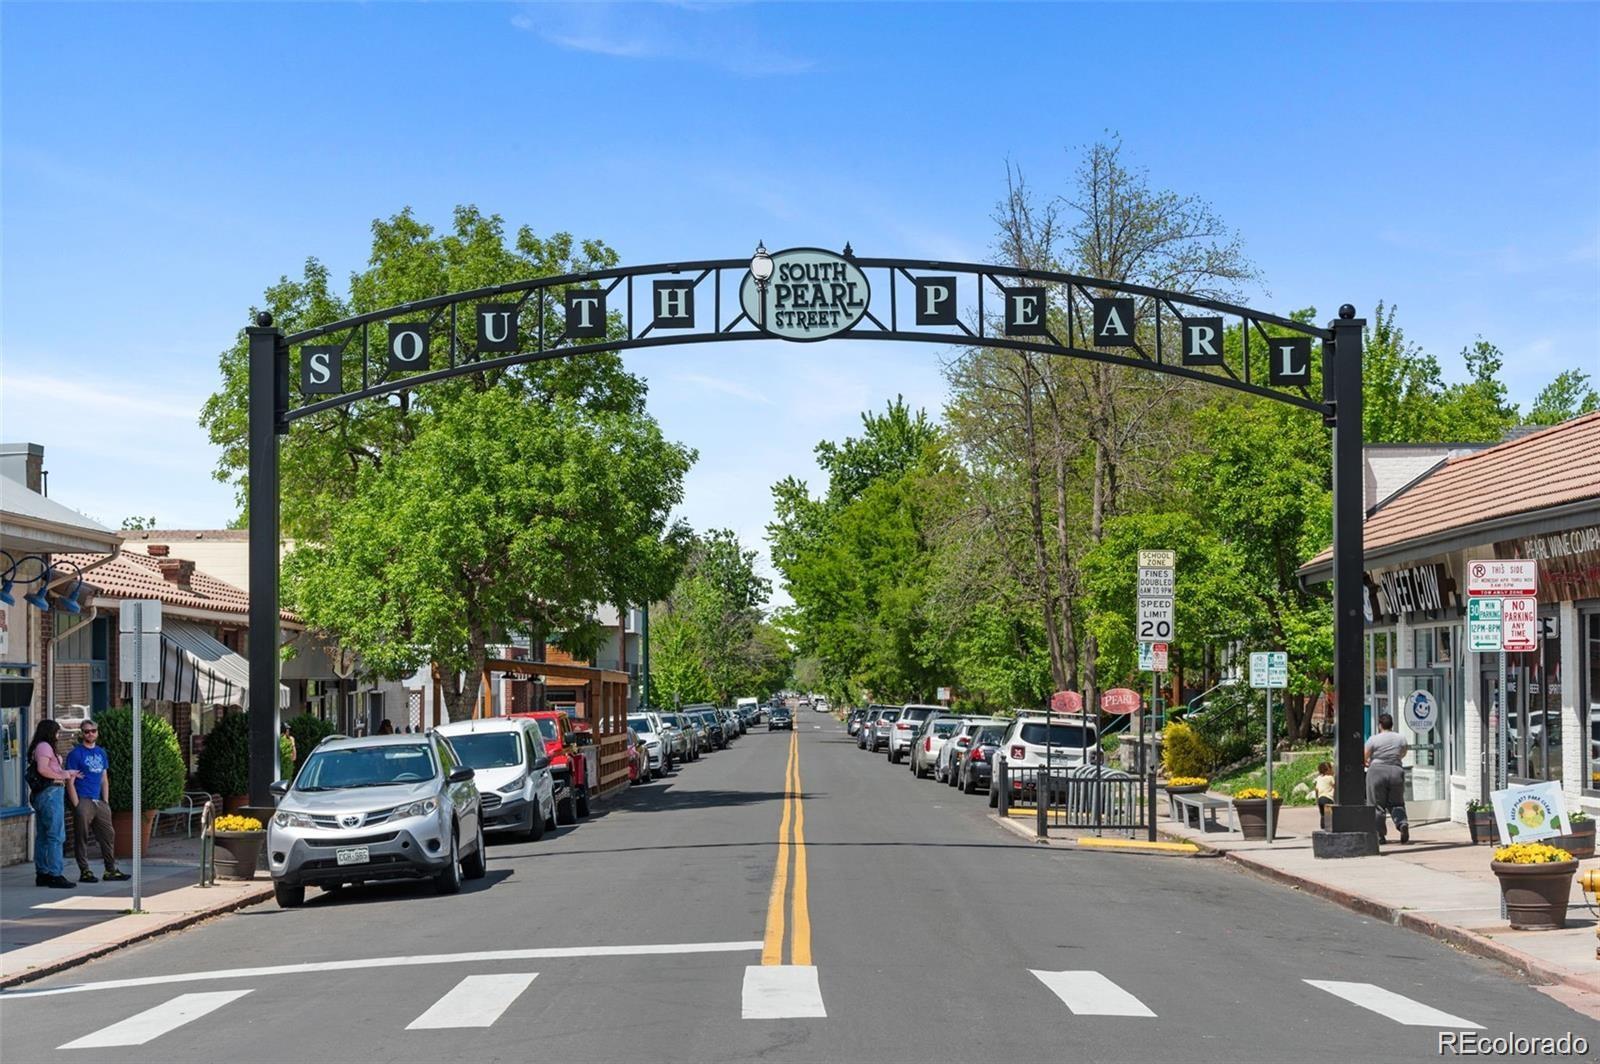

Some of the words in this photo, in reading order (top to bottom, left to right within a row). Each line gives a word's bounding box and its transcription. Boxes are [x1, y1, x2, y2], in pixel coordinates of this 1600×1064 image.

[779, 262, 847, 282] SOUTH
[775, 282, 864, 318] PEARL
[775, 311, 840, 330] STREET
[1524, 538, 1550, 560] PEARL
[1547, 534, 1572, 558] WINE
[1142, 552, 1171, 560] SCHOOL
[1145, 570, 1169, 578] FINES
[1491, 566, 1505, 574] THIS
[1510, 566, 1524, 574] SIDE
[1380, 569, 1417, 615] SWEET
[1413, 564, 1442, 611] COW
[1140, 600, 1171, 608] SPEED
[1470, 604, 1480, 616] 30
[1512, 600, 1525, 611] NO
[1504, 611, 1533, 622] PARKING
[1141, 621, 1171, 637] 20
[1511, 630, 1526, 638] TIME
[1104, 695, 1136, 707] PEARL
